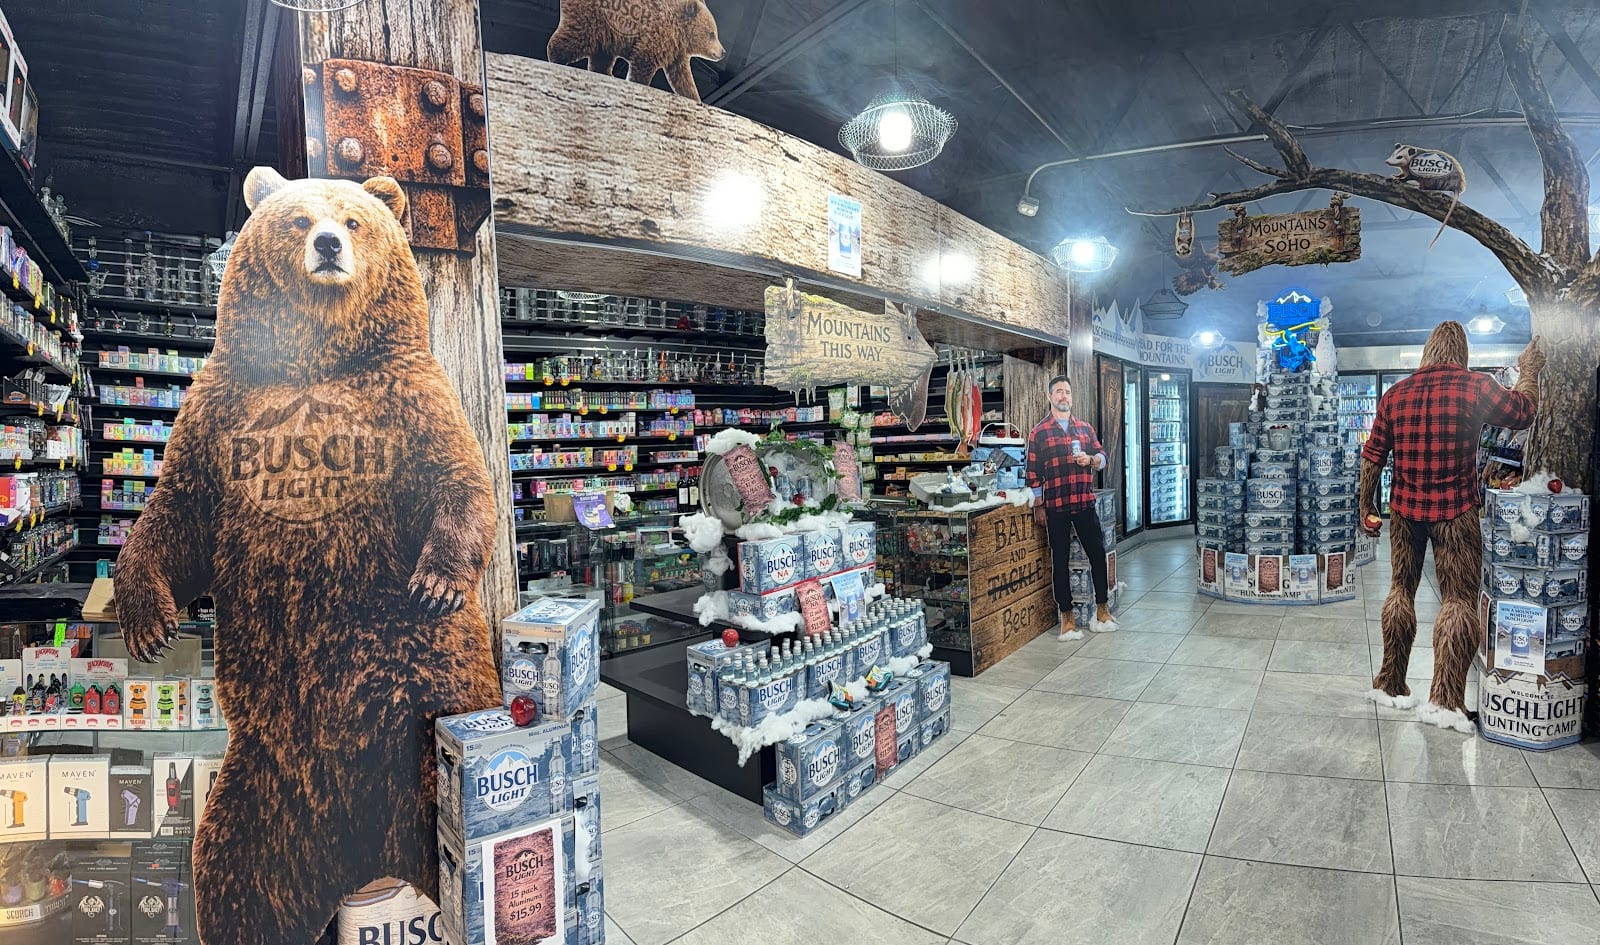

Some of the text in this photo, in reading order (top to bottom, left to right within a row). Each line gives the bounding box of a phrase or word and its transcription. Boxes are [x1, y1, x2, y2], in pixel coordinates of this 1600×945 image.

[1410, 158, 1453, 171] BUSCH
[1248, 216, 1328, 238] MOUNTAINS
[1263, 239, 1311, 254] SOHO
[806, 311, 891, 343] MOUNTAINS
[820, 340, 883, 361] THIS WAY
[1155, 341, 1173, 353] FOR
[1175, 344, 1191, 355] THE
[1208, 354, 1243, 369] BUSCH
[229, 434, 387, 481] BUSCH
[733, 458, 752, 471] BUSCH
[261, 476, 349, 500] LIGHT
[1256, 491, 1286, 499] BUSCH
[993, 513, 1037, 552] BAIT
[811, 545, 837, 562] BUSCH
[849, 539, 872, 553] BUSCH
[767, 554, 797, 574] BUSCH
[819, 559, 830, 567] NA
[1009, 548, 1027, 564] AND
[777, 570, 789, 578] NA
[1002, 604, 1036, 643] Beer
[860, 640, 881, 657] BUSCH
[508, 667, 539, 681] BUSCH
[816, 657, 842, 674] BUSCH
[515, 679, 533, 687] LIGHT
[760, 679, 792, 701] BUSCH
[767, 694, 785, 706] LIGHT
[925, 682, 946, 704] BUSCH
[1511, 689, 1544, 699] WELCOME
[896, 699, 915, 720] USCH
[463, 713, 508, 728] BUSC
[1546, 720, 1577, 736] CAMP
[853, 725, 874, 750] BUSC
[809, 747, 840, 779] BUSCH
[62, 770, 95, 778] MAVEN
[477, 764, 538, 797] BUSCH
[816, 767, 834, 782] LIGHT
[491, 787, 527, 805] LIGHT
[505, 854, 544, 878] BUSCH
[513, 869, 536, 882] LIGHT
[510, 884, 539, 898] 15 pack
[508, 892, 543, 909] Aluminums
[6, 909, 34, 920] SCORCH
[510, 902, 542, 922] $15.99
[358, 911, 442, 945] BUSC
